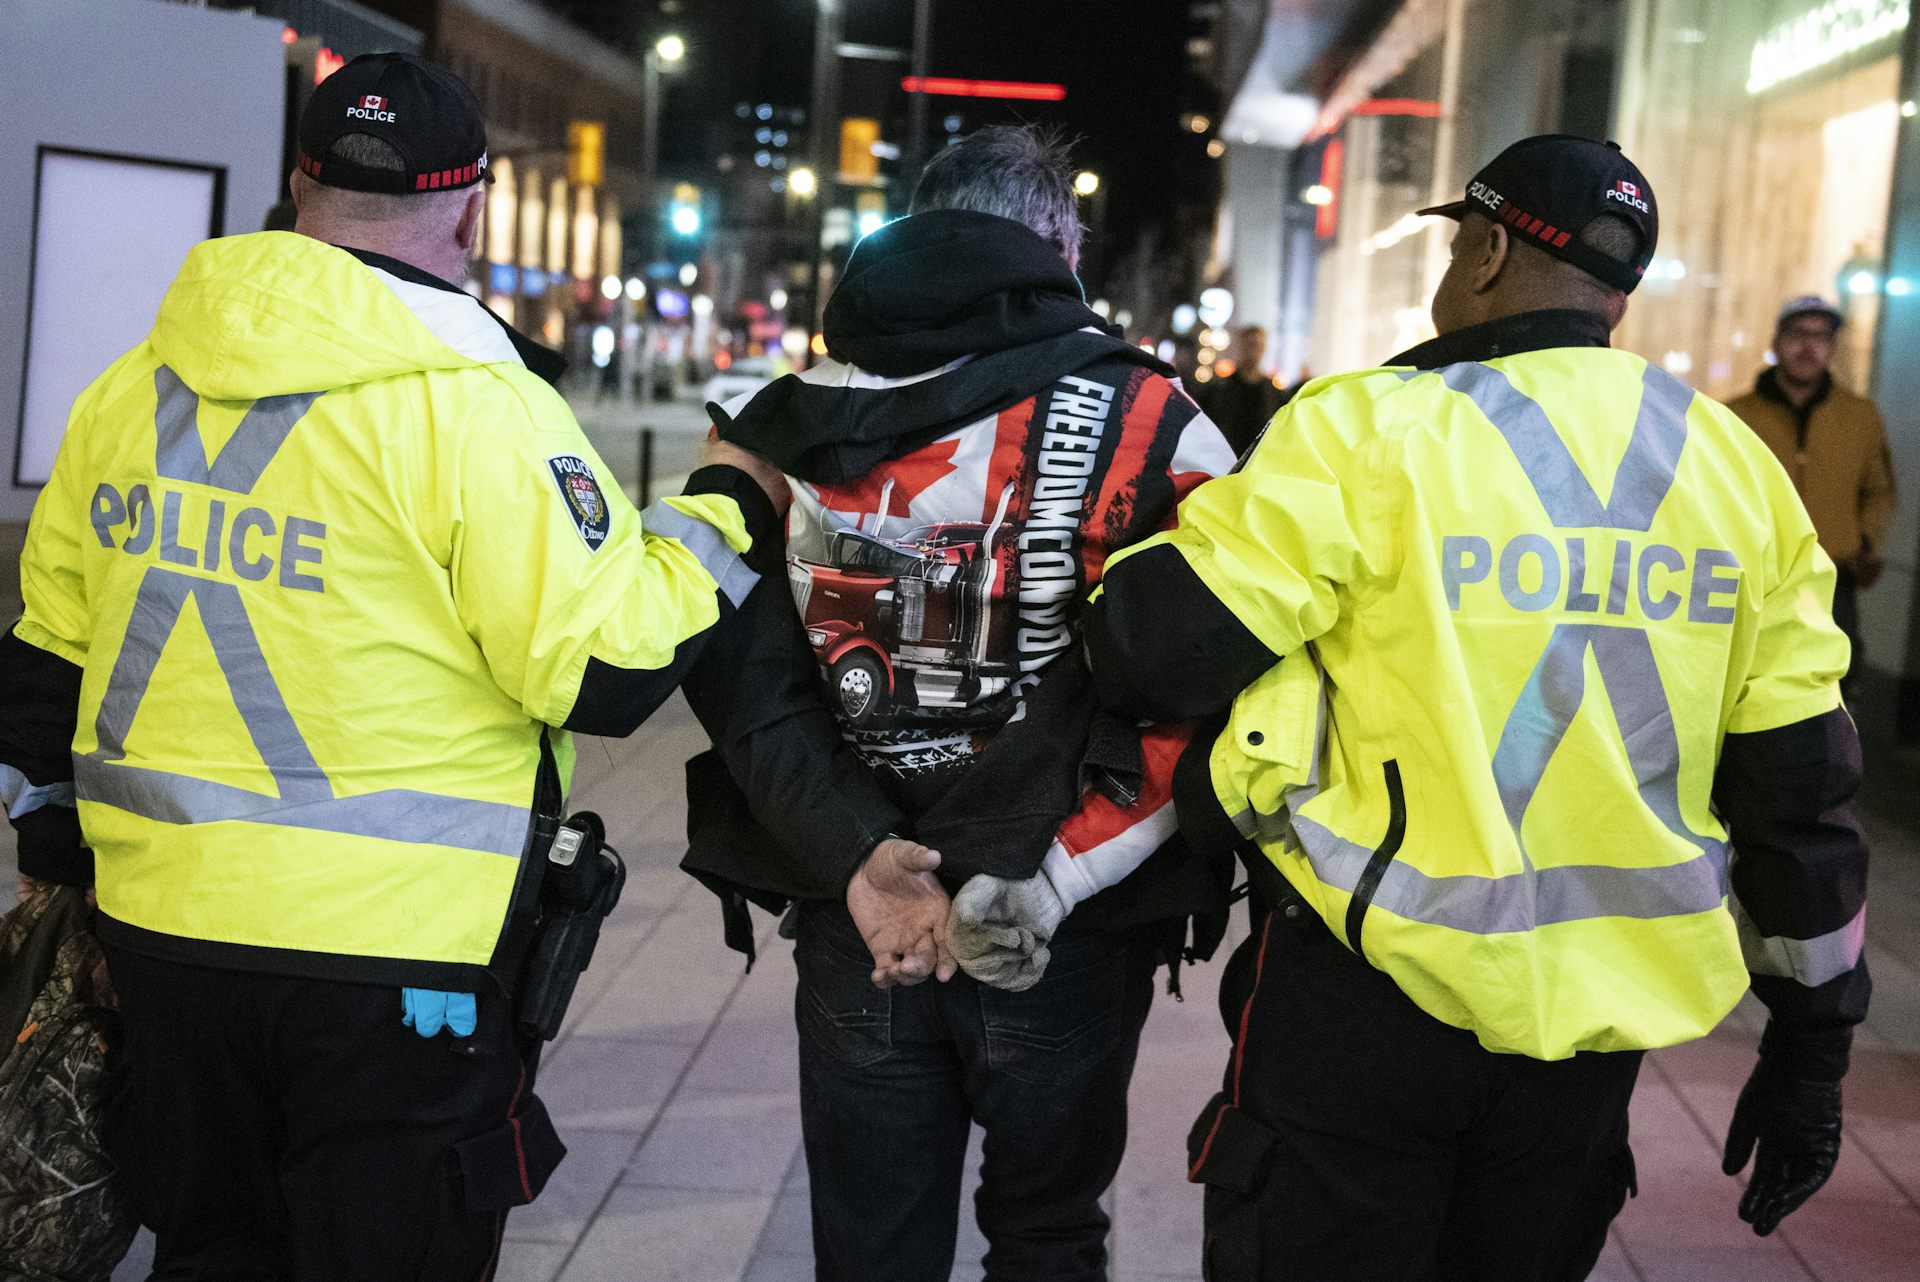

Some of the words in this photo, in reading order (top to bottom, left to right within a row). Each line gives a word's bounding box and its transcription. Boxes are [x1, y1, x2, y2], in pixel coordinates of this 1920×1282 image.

[346, 106, 397, 123] POLICE
[1467, 181, 1504, 210] POLICE
[1606, 189, 1649, 214] POLICE
[553, 457, 593, 480] POLICE
[90, 482, 327, 594] POLICE
[580, 520, 605, 540] Ottawa
[1441, 533, 1744, 625] POLICE
